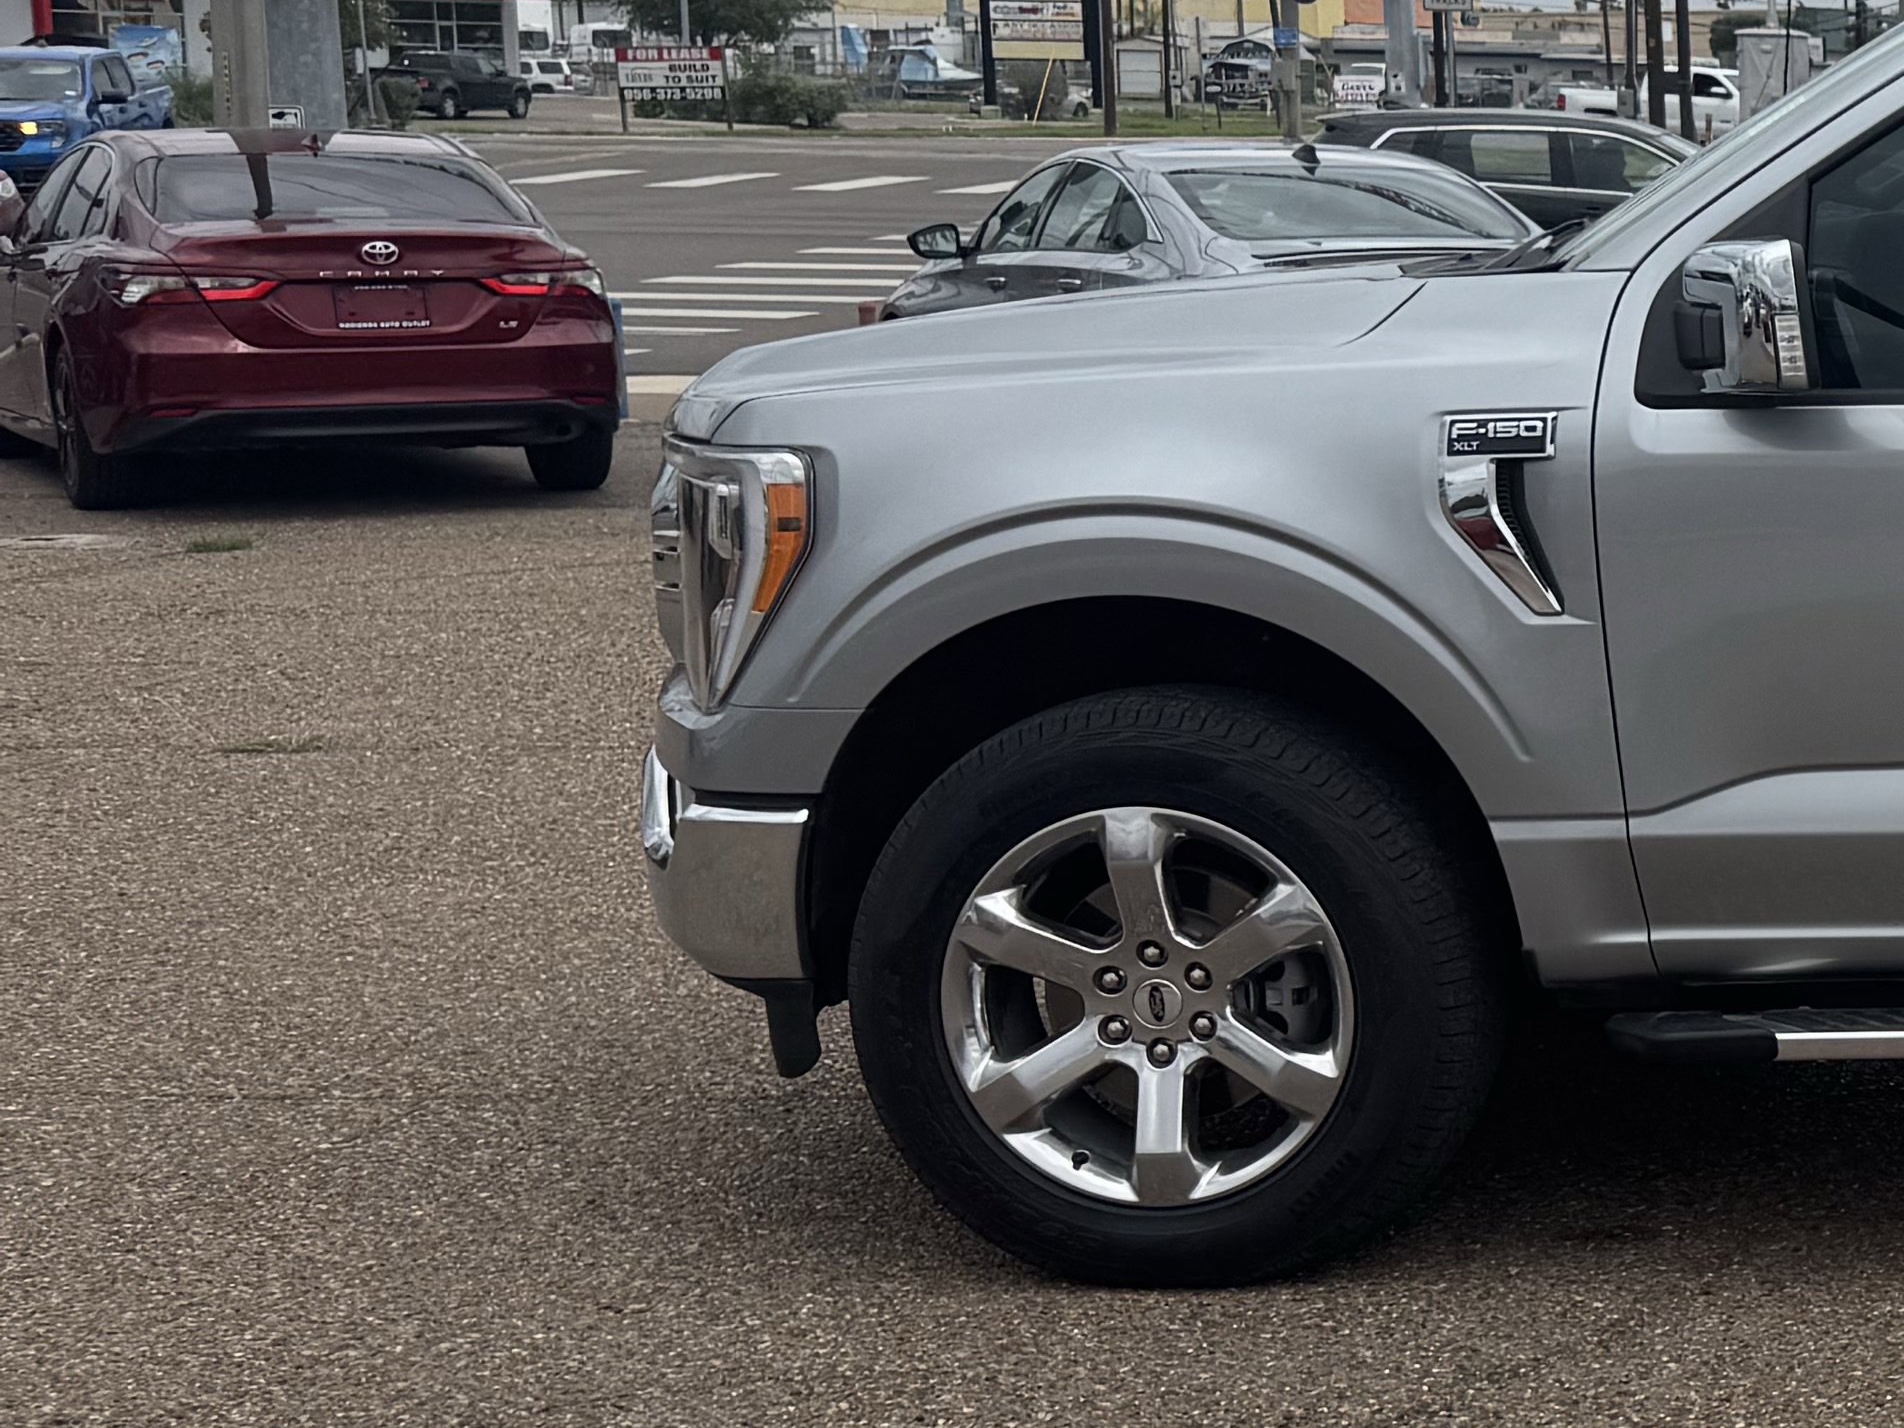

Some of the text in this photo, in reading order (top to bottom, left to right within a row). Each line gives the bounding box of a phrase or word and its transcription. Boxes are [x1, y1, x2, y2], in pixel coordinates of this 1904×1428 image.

[626, 47, 710, 61] FOR LEASE
[668, 63, 710, 73] BUILD
[663, 74, 682, 85] TO
[685, 74, 718, 85] SUIT
[1450, 420, 1544, 439] F-150
[1453, 441, 1480, 451] XLT
